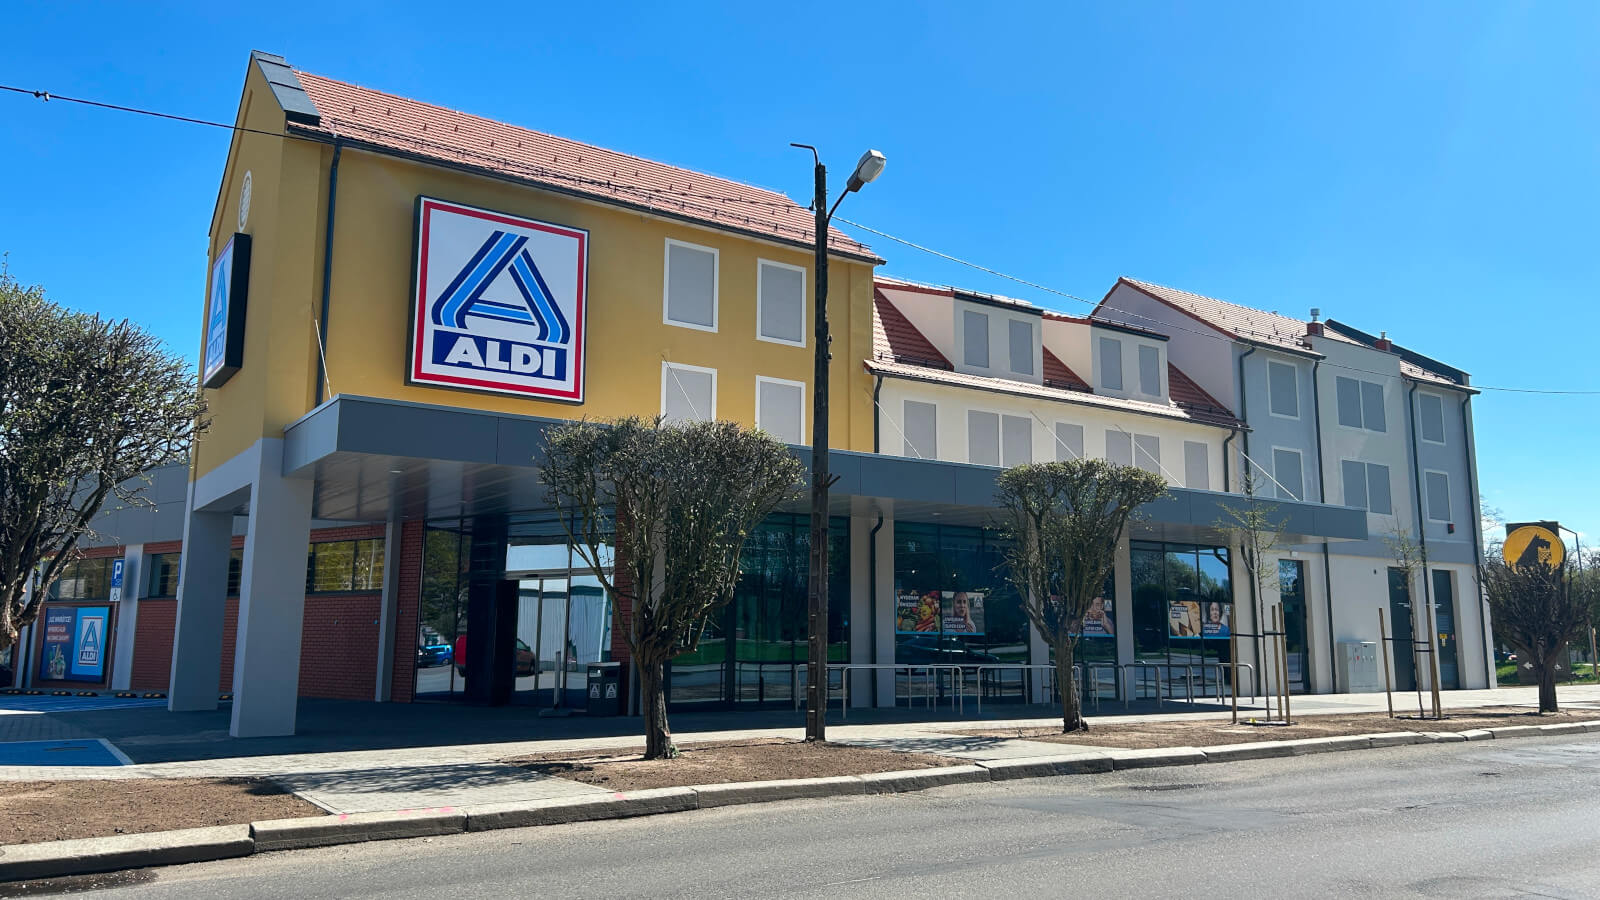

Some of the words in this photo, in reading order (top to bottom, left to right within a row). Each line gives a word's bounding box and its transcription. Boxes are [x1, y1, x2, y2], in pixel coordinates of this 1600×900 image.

[444, 336, 556, 377] ALDI
[114, 561, 122, 579] P
[81, 650, 97, 660] ALDI
